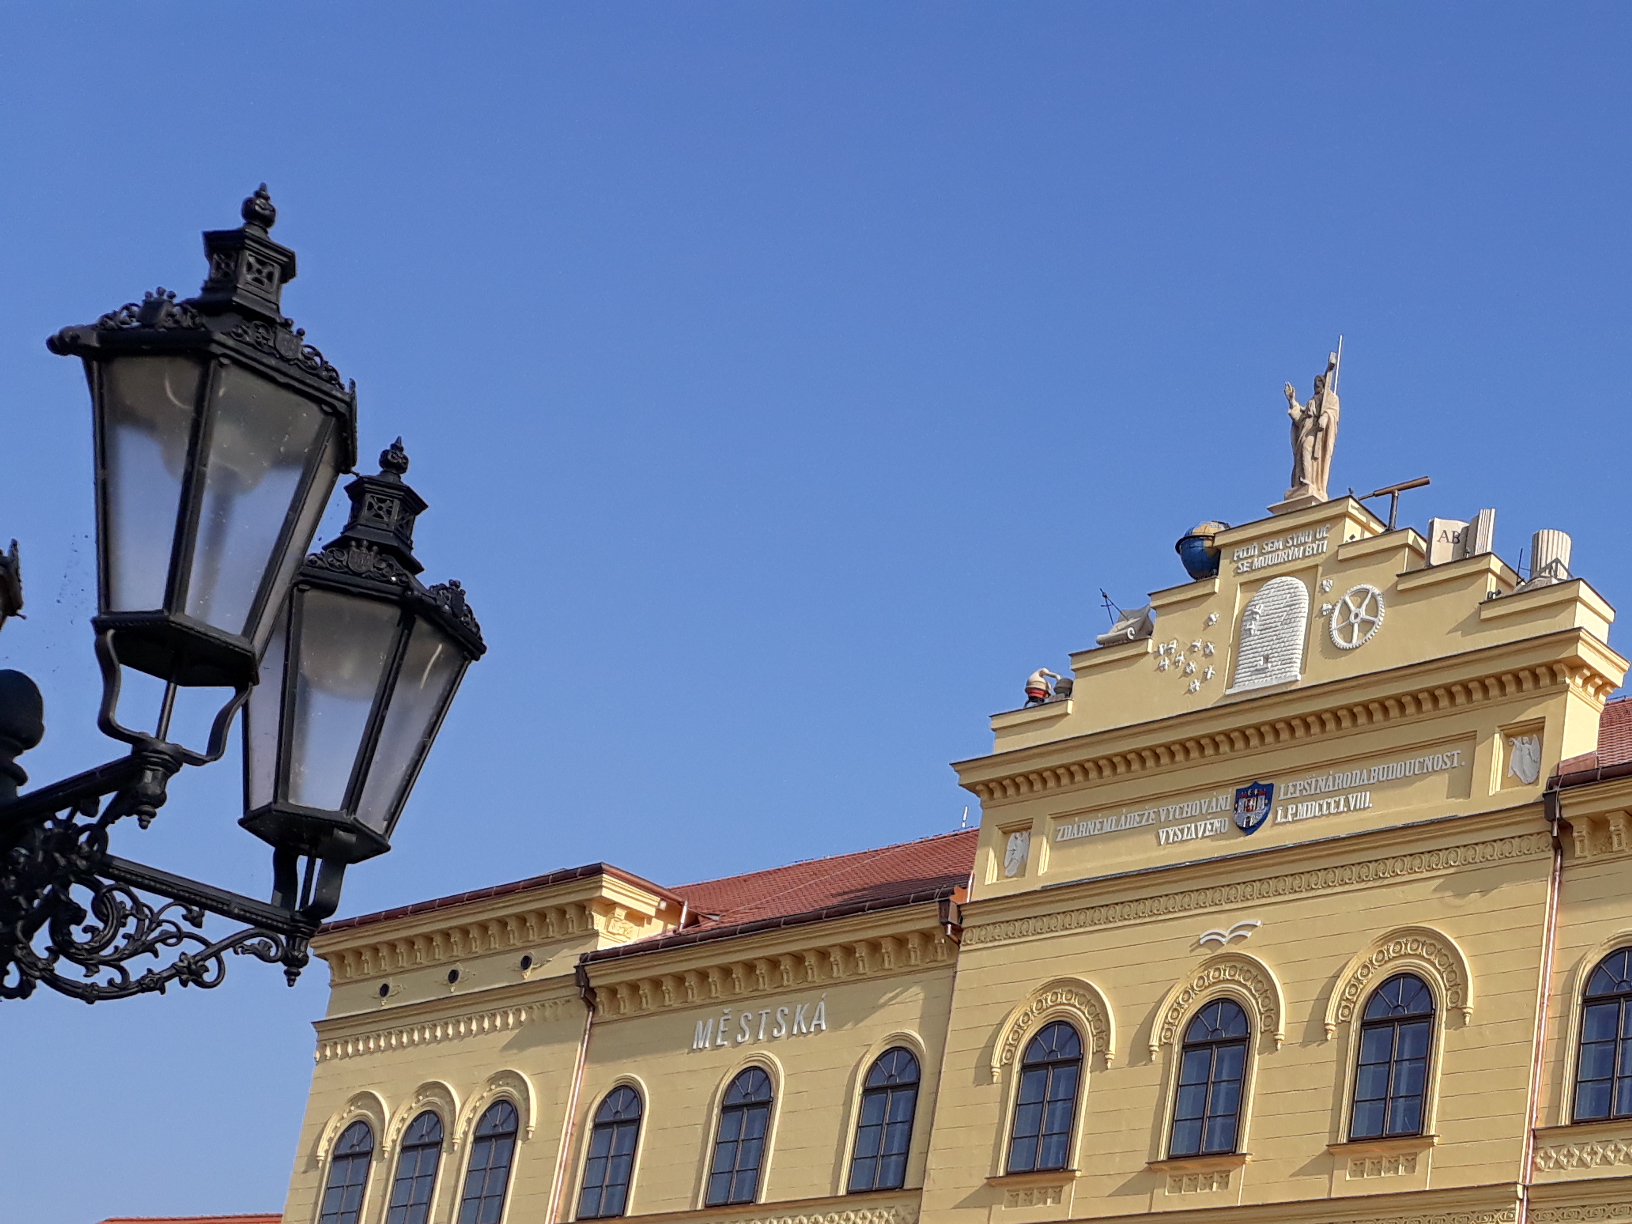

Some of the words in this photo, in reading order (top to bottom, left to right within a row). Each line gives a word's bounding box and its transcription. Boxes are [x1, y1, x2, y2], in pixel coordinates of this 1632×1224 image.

[1437, 529, 1461, 545] AB
[1237, 558, 1252, 573] SE
[692, 992, 828, 1050] MĚSTSKÁ
